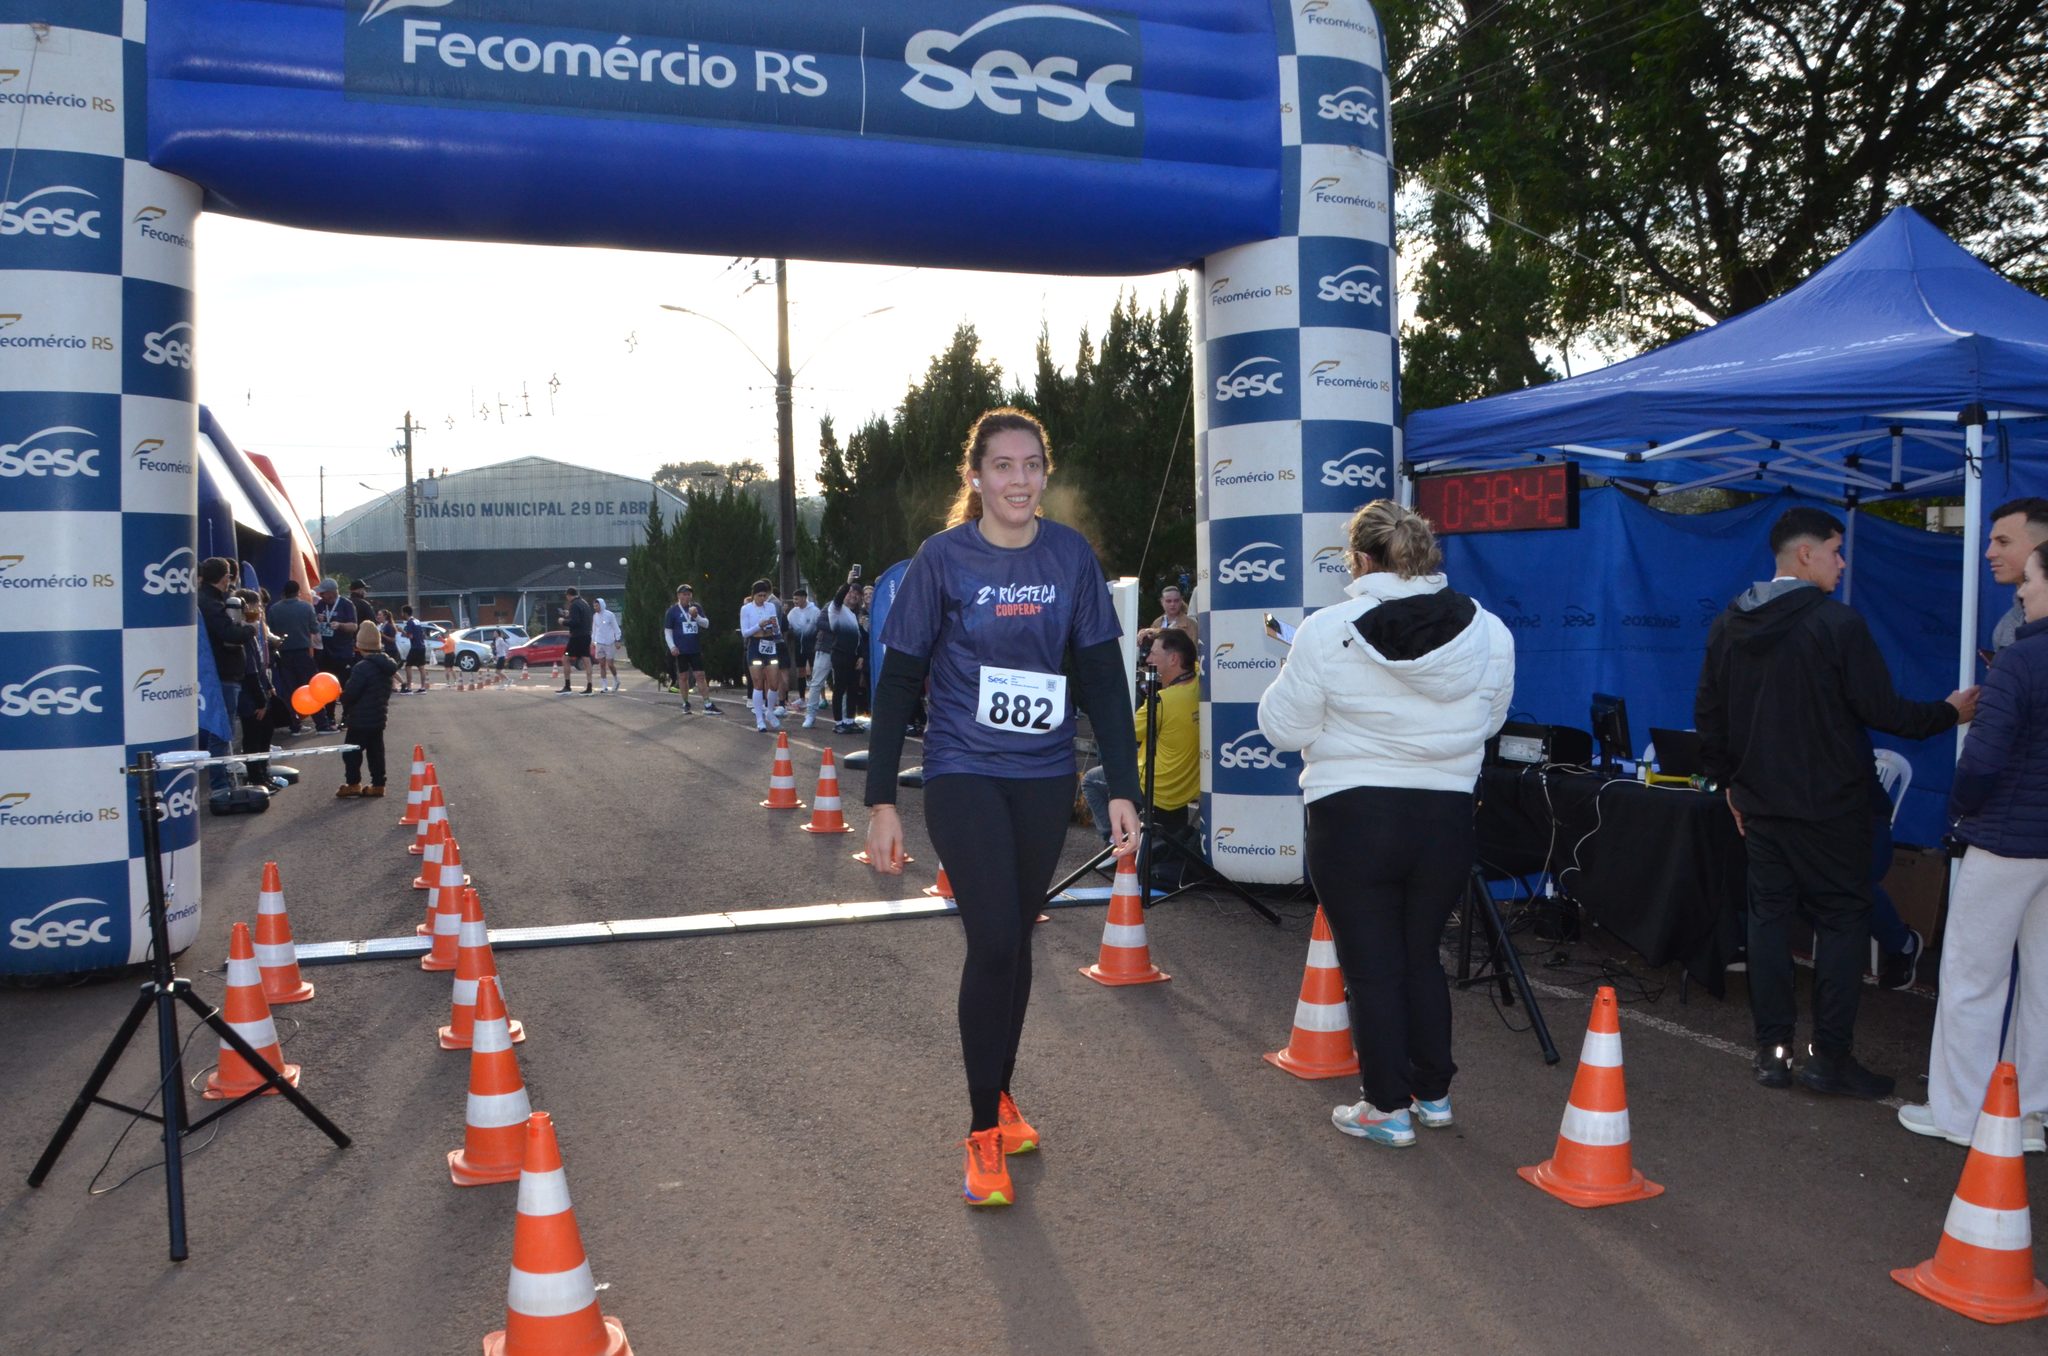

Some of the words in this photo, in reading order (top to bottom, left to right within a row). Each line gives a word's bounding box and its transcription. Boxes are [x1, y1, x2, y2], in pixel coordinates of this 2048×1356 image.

[1308, 14, 1366, 34] Fecomércio
[403, 19, 737, 88] Fecomércio
[756, 50, 828, 97] RS
[900, 28, 1136, 127] Sesc
[0, 91, 87, 108] ecomércio
[92, 97, 115, 112] RS
[1318, 93, 1379, 129] Sesc
[1316, 192, 1376, 209] Fecomércio
[0, 201, 100, 239] Sesc
[1212, 287, 1271, 306] Fecomércio
[1275, 285, 1293, 296] RS
[1317, 275, 1383, 307] Sesc
[0, 334, 86, 348] ecomércio
[92, 336, 114, 350] RS
[142, 332, 193, 369] Ses
[1216, 371, 1283, 402] Sesc
[1316, 375, 1378, 389] Fecomércio
[0, 444, 99, 477] Sesc
[1215, 471, 1274, 486] Fecomércio
[1278, 470, 1295, 481] RS
[1320, 459, 1386, 489] Sesc
[481, 502, 566, 517] MUNICIPAL
[571, 501, 591, 515] 29
[595, 501, 614, 515] DE
[620, 501, 648, 514] ABR
[93, 574, 114, 587] RS
[1218, 558, 1286, 584] Sesc
[999, 583, 1056, 604] RÚSTICA
[995, 603, 1043, 616] COOPERA+
[1217, 657, 1276, 670] Fecomércio
[987, 675, 1008, 685] Sesc
[1, 683, 103, 716] Sesc
[989, 691, 1053, 729] 882
[1219, 742, 1287, 769] Sesc
[1, 811, 93, 826] Fecomércio
[99, 807, 120, 820] RS
[1217, 842, 1276, 856] Fecomércio
[1280, 845, 1297, 856] RS
[9, 915, 111, 950] Sesc
